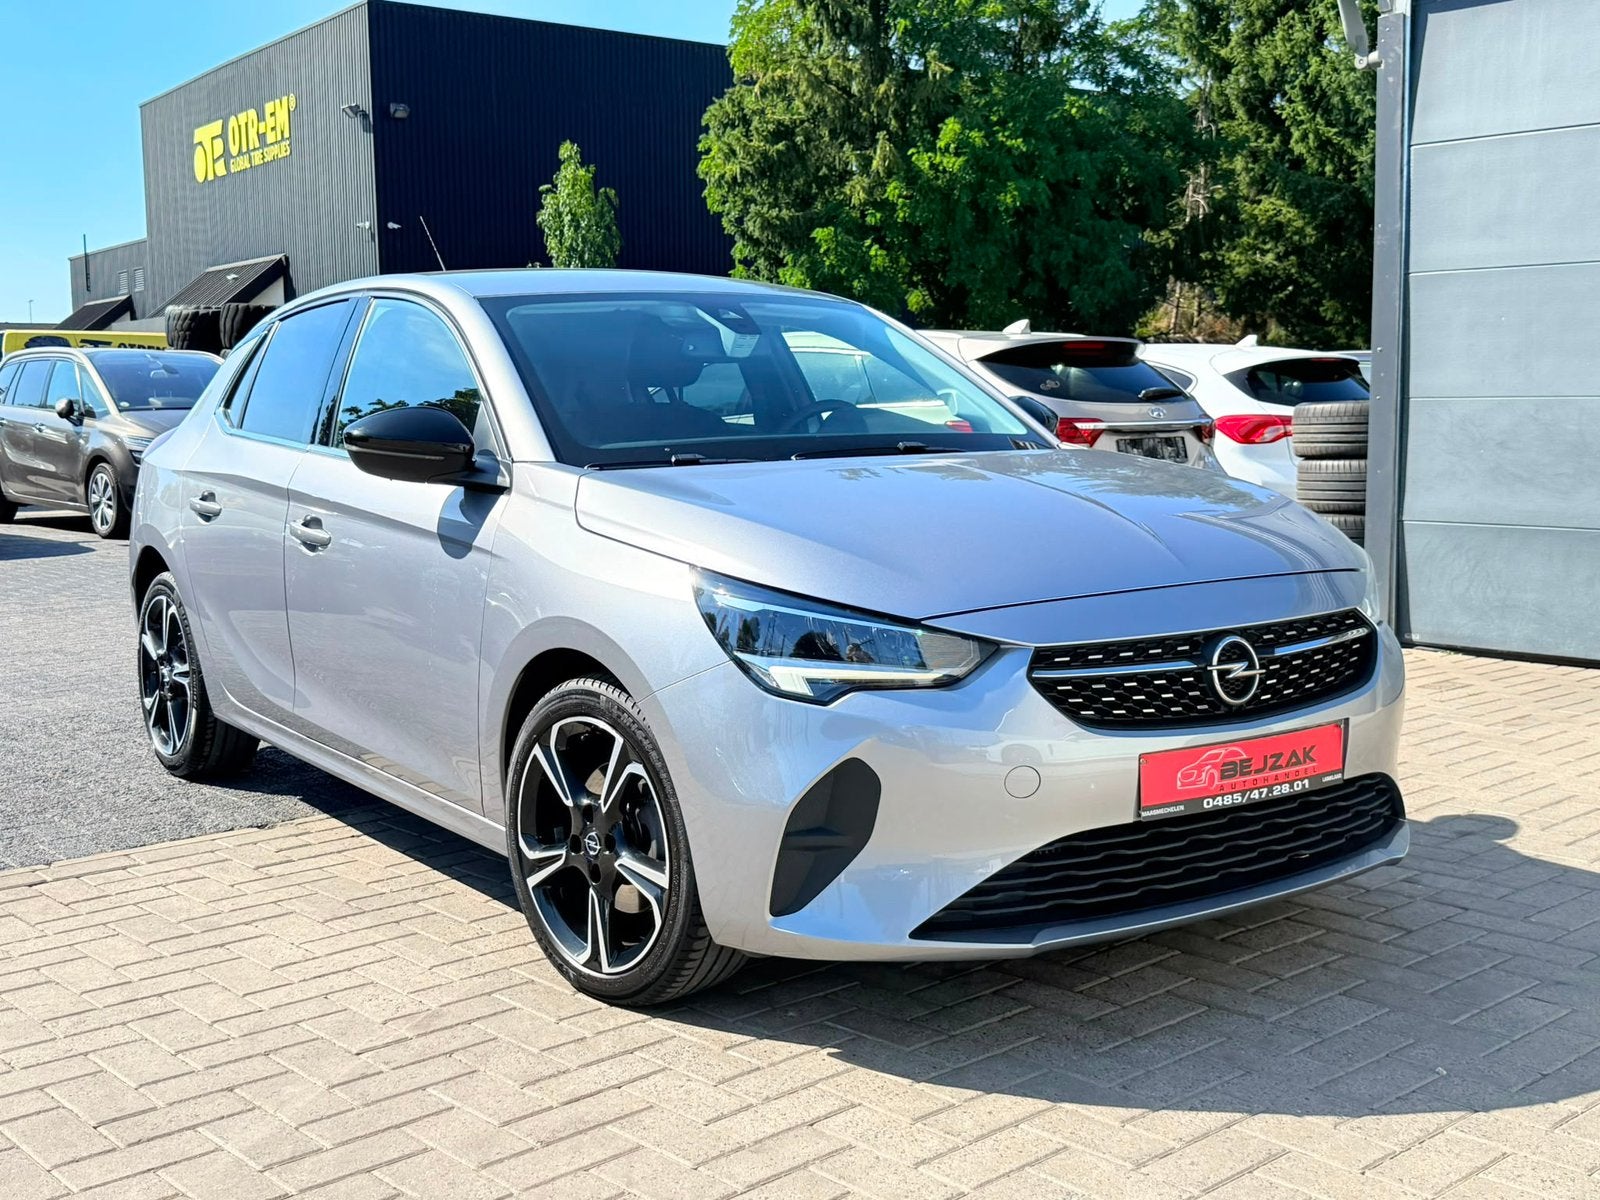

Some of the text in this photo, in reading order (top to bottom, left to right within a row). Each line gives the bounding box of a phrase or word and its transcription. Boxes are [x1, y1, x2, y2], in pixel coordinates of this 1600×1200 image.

[1220, 745, 1317, 780] BEJZAK
[1203, 779, 1310, 809] 0485/47.28.01
[1219, 767, 1318, 792] AUTOHANDEL
